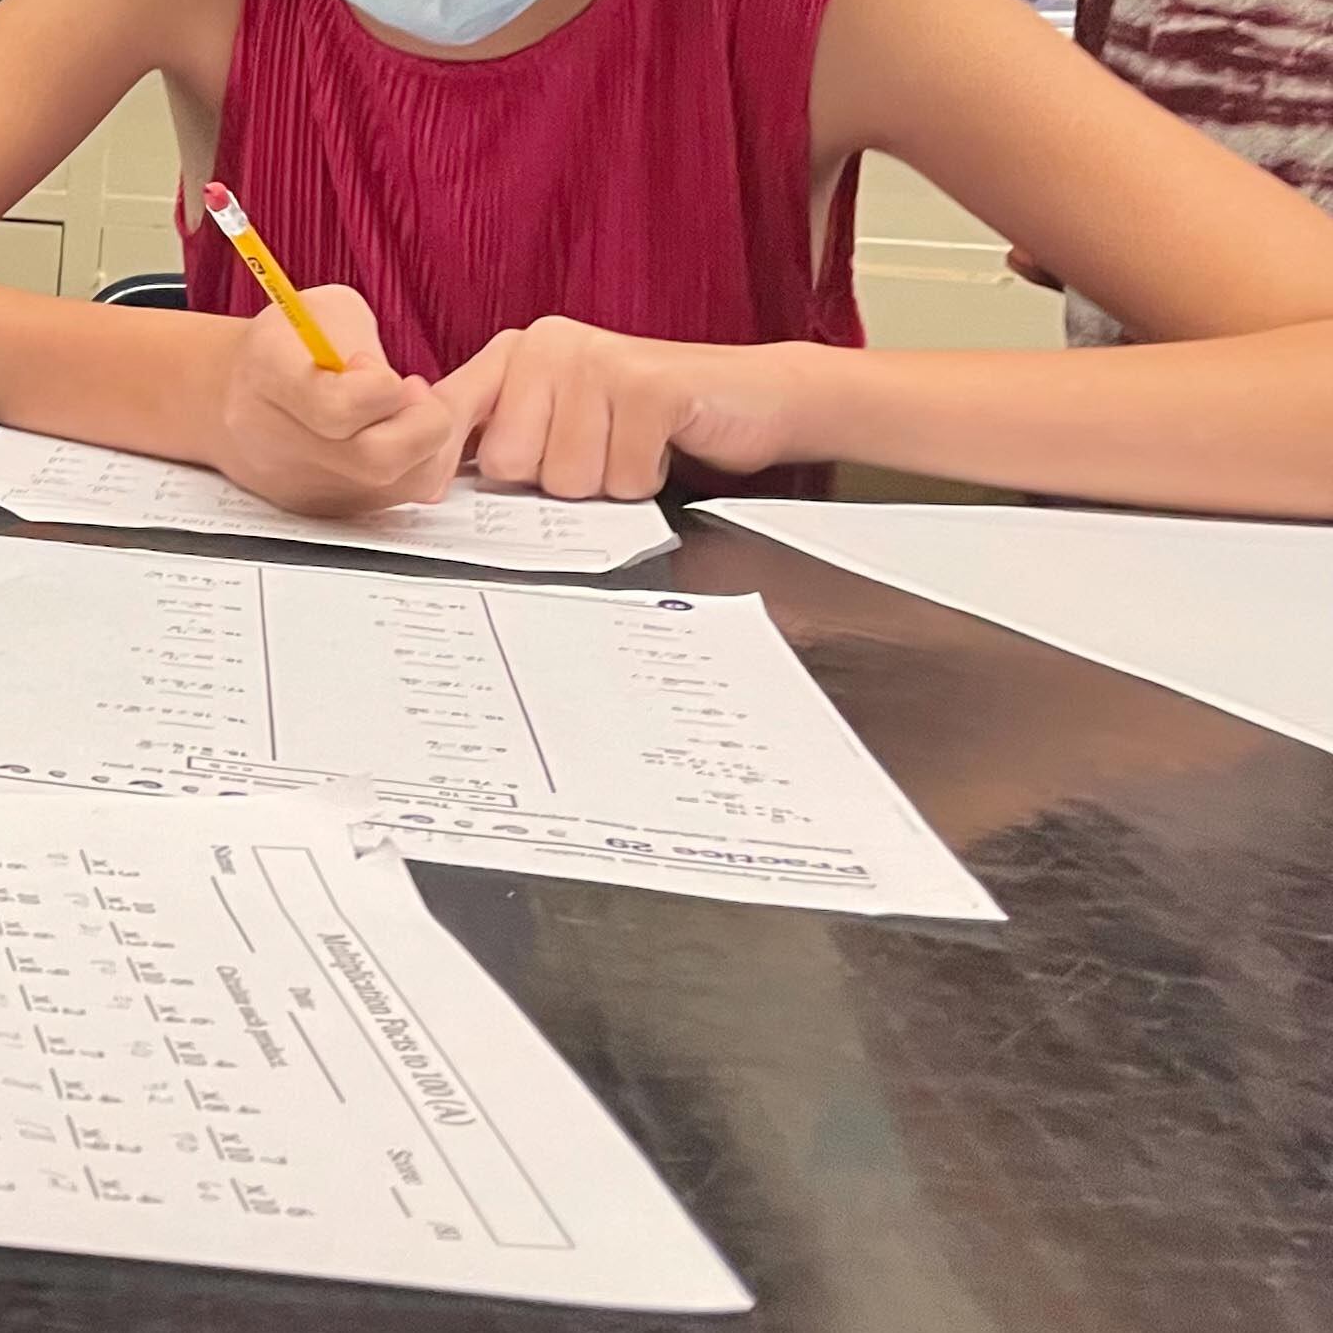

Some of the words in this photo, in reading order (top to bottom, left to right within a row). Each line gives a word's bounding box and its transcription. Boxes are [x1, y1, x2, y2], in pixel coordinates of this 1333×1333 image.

[604, 836, 655, 854] 29
[672, 845, 869, 876] Practice
[375, 1017, 419, 1053] Facts
[400, 1053, 429, 1069] to
[411, 1071, 456, 1097] 100
[423, 1098, 477, 1127] (A)
